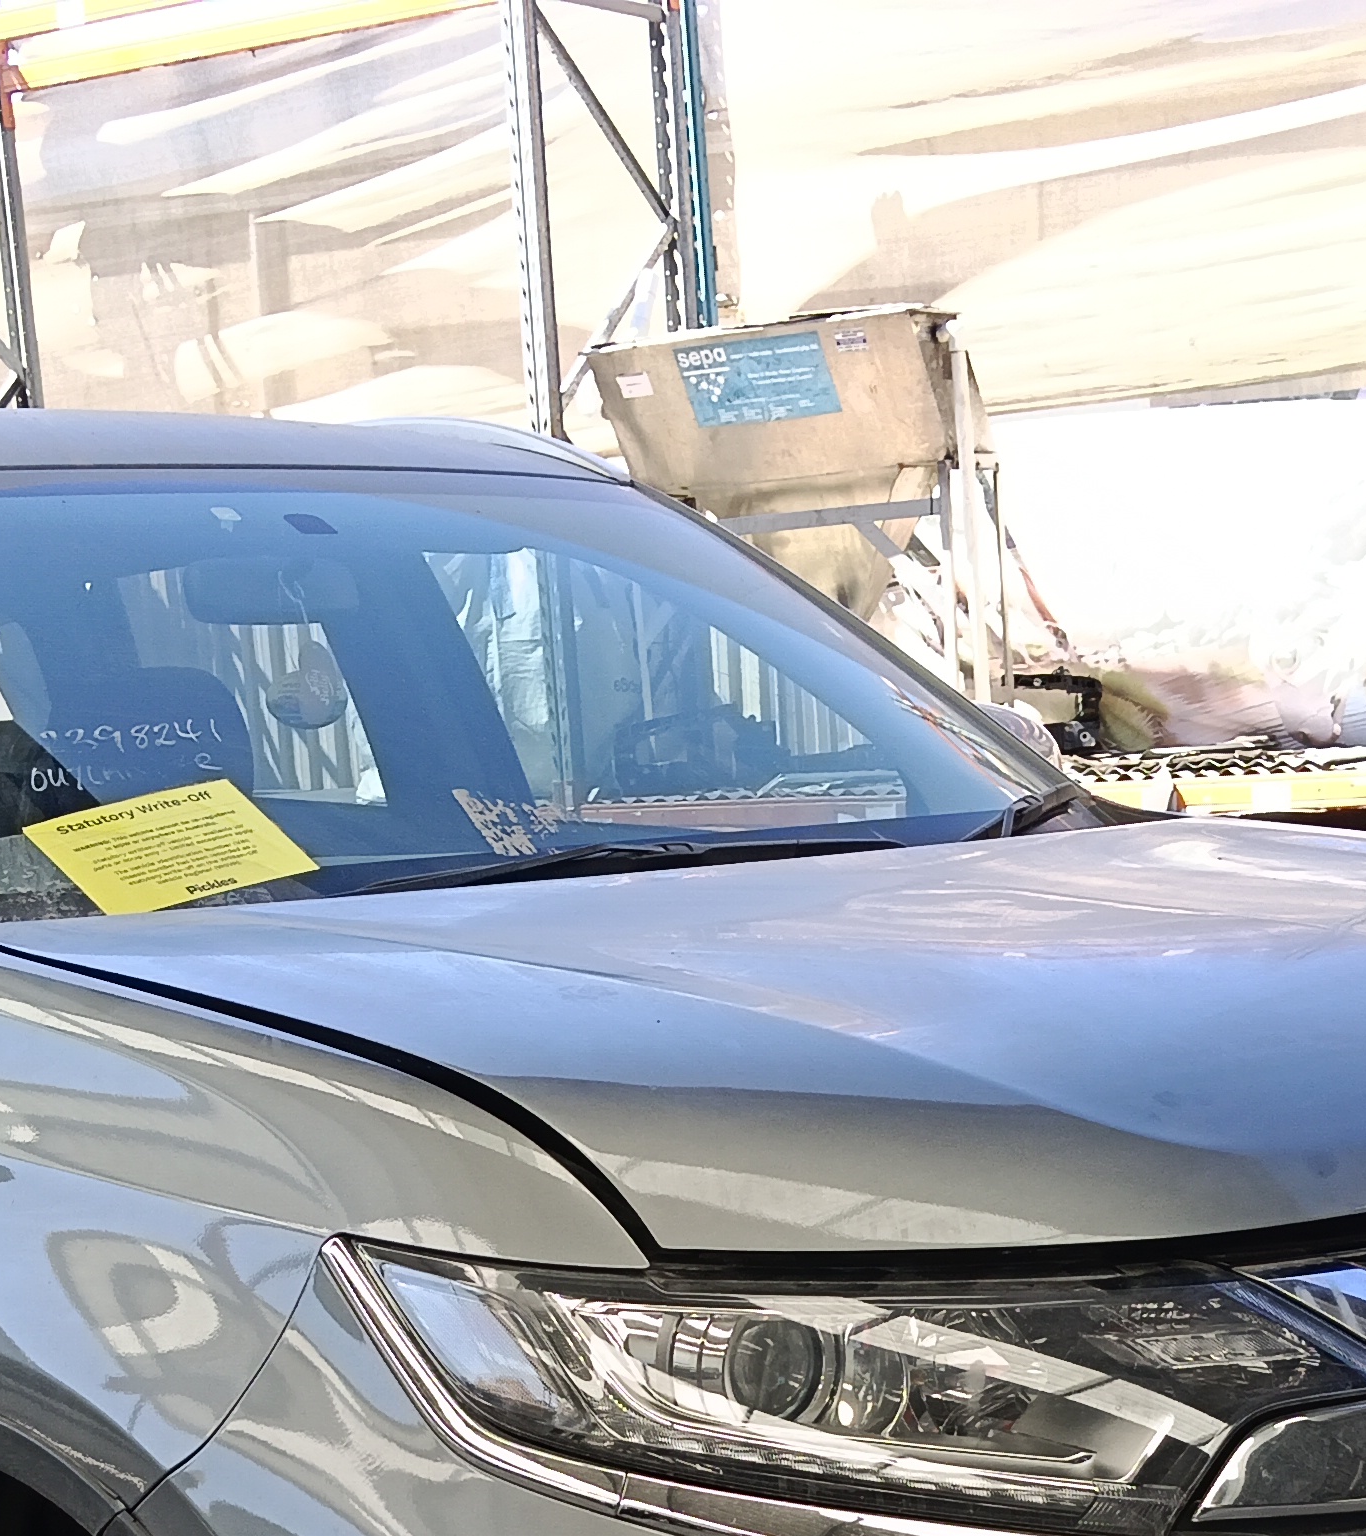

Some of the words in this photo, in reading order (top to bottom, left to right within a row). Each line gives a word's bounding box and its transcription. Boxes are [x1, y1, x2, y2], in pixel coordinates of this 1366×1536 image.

[677, 347, 727, 369] sepa
[56, 809, 135, 834] Statutory
[135, 790, 212, 813] Write-Off
[185, 878, 238, 895] Pickles
